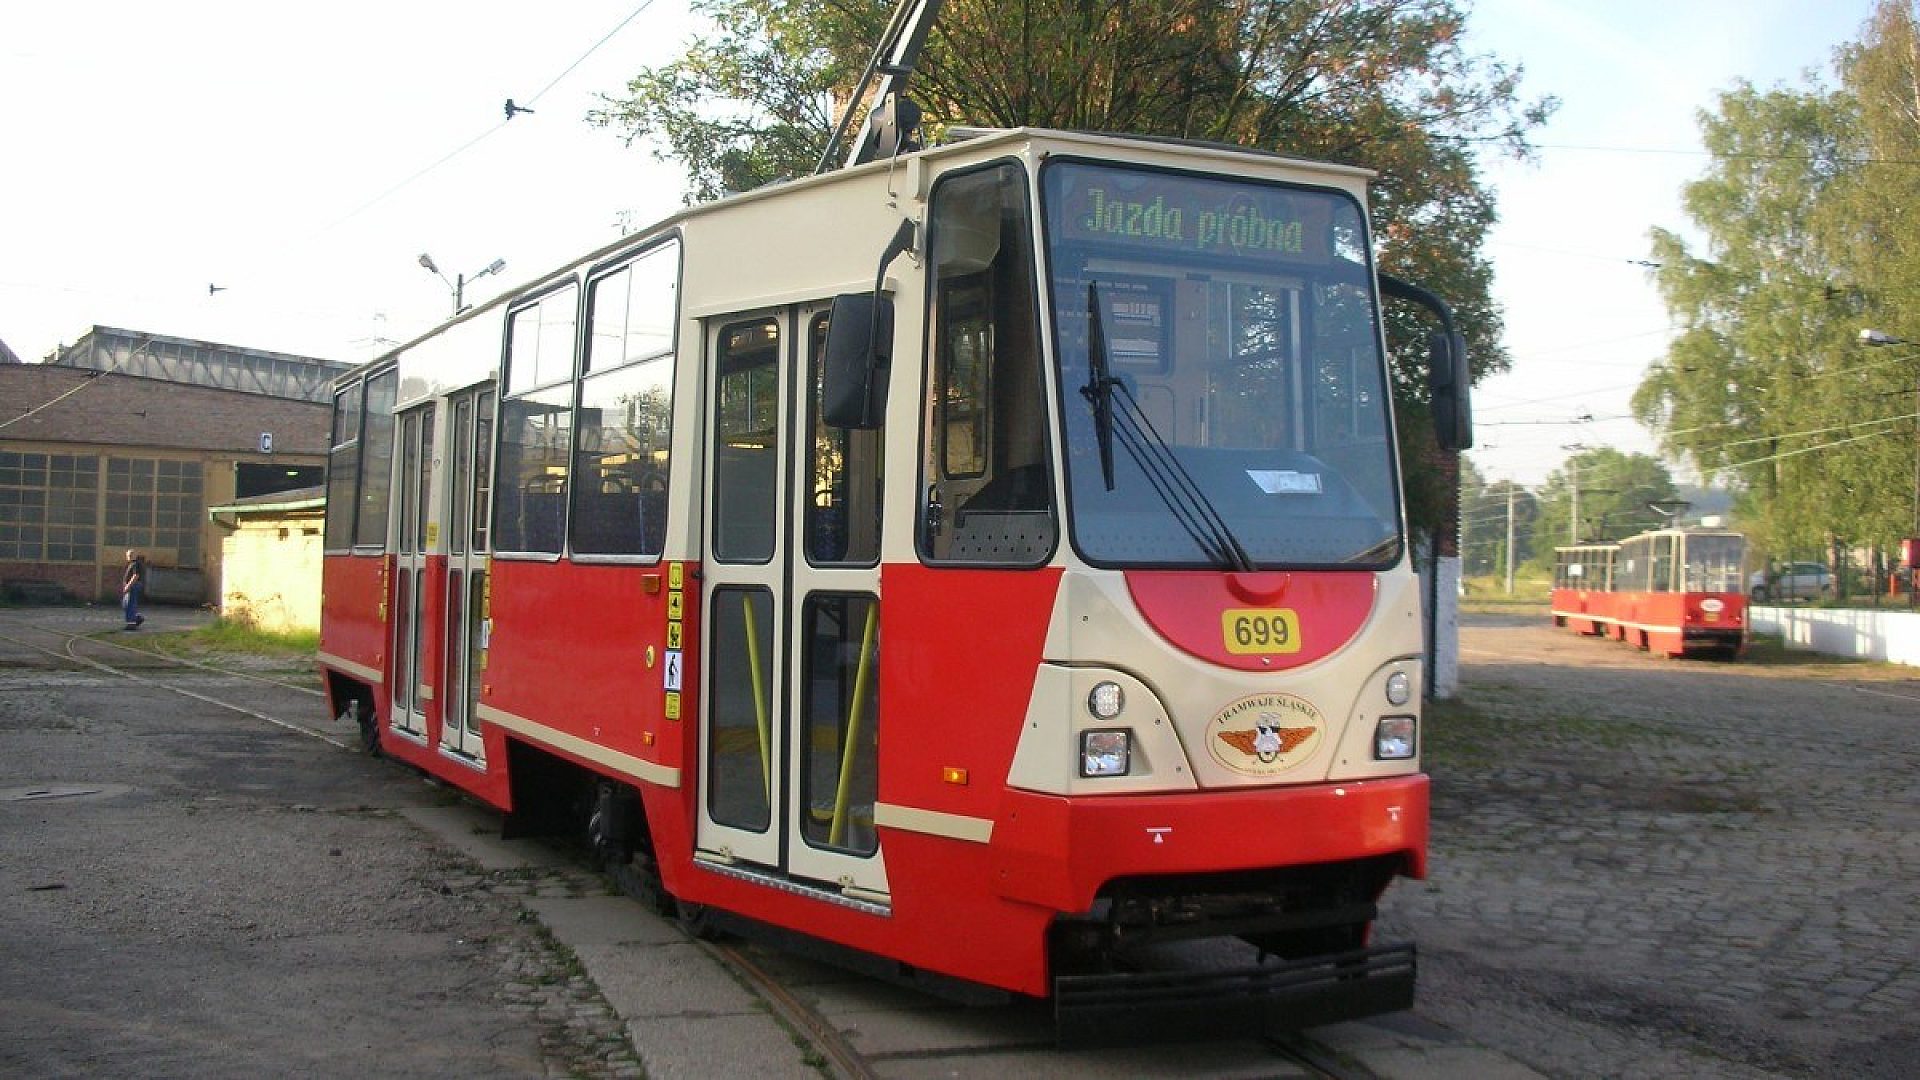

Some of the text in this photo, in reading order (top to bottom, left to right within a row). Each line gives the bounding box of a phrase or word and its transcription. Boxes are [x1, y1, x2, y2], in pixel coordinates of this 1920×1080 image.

[1087, 188, 1302, 252] Jazda próbna
[1235, 616, 1288, 645] 699
[1217, 697, 1273, 725] TRAMWAJE
